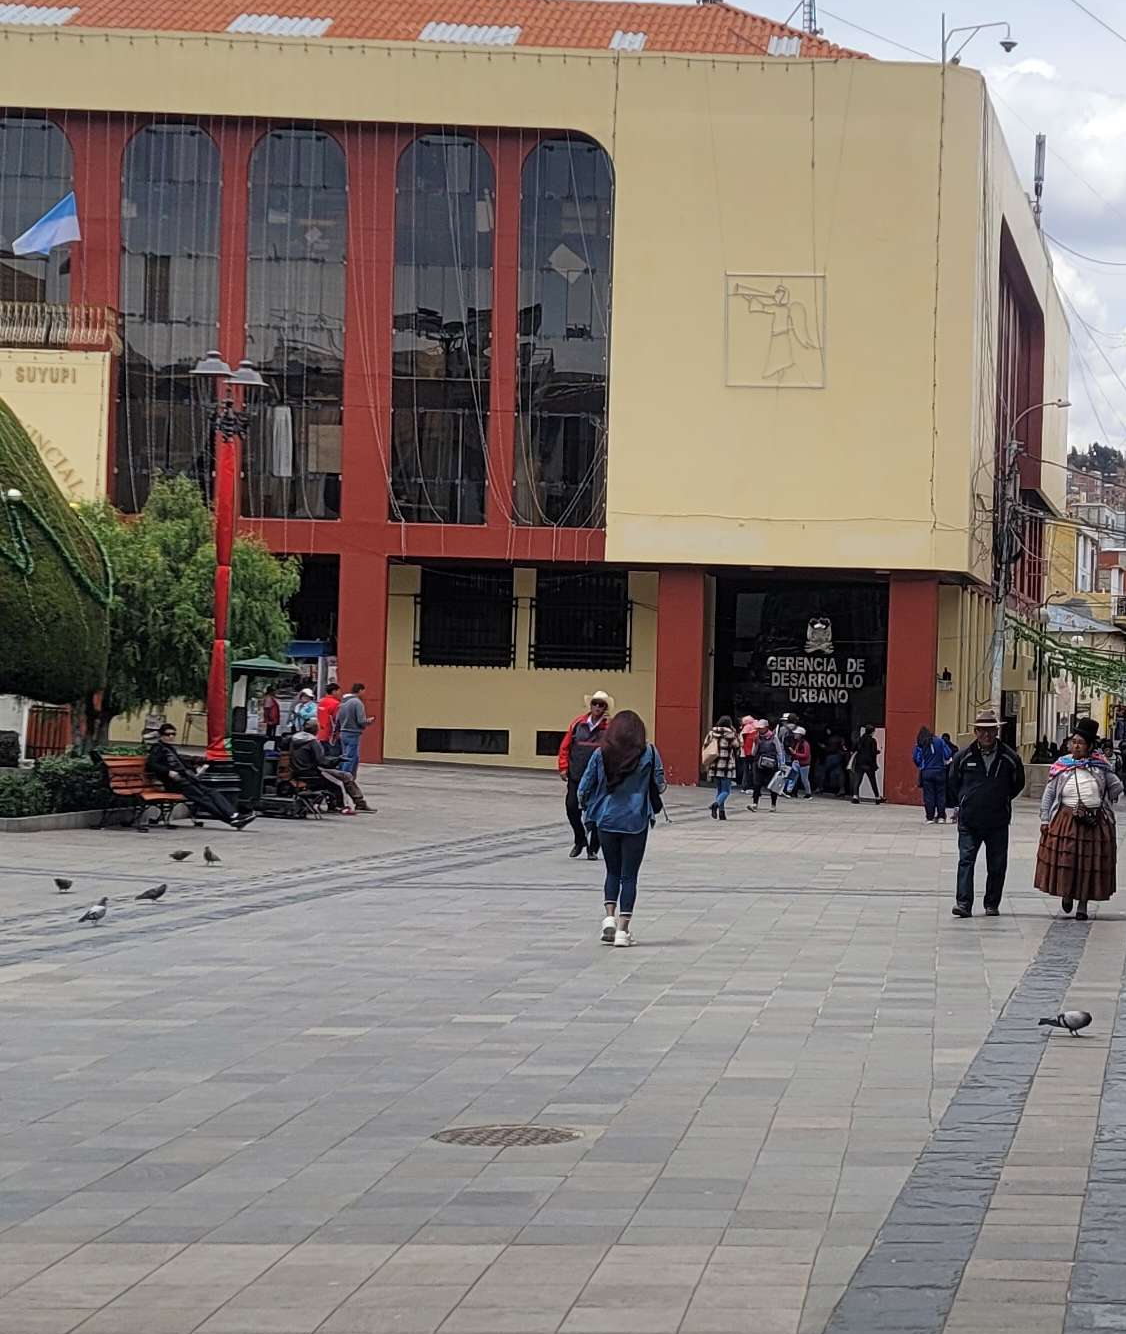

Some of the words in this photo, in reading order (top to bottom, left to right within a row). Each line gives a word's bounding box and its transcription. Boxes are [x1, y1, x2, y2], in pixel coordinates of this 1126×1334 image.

[766, 656, 838, 673] GERENCIA
[846, 657, 866, 673] DE
[770, 671, 864, 689] DESARROLLO
[788, 687, 849, 704] URBANO
